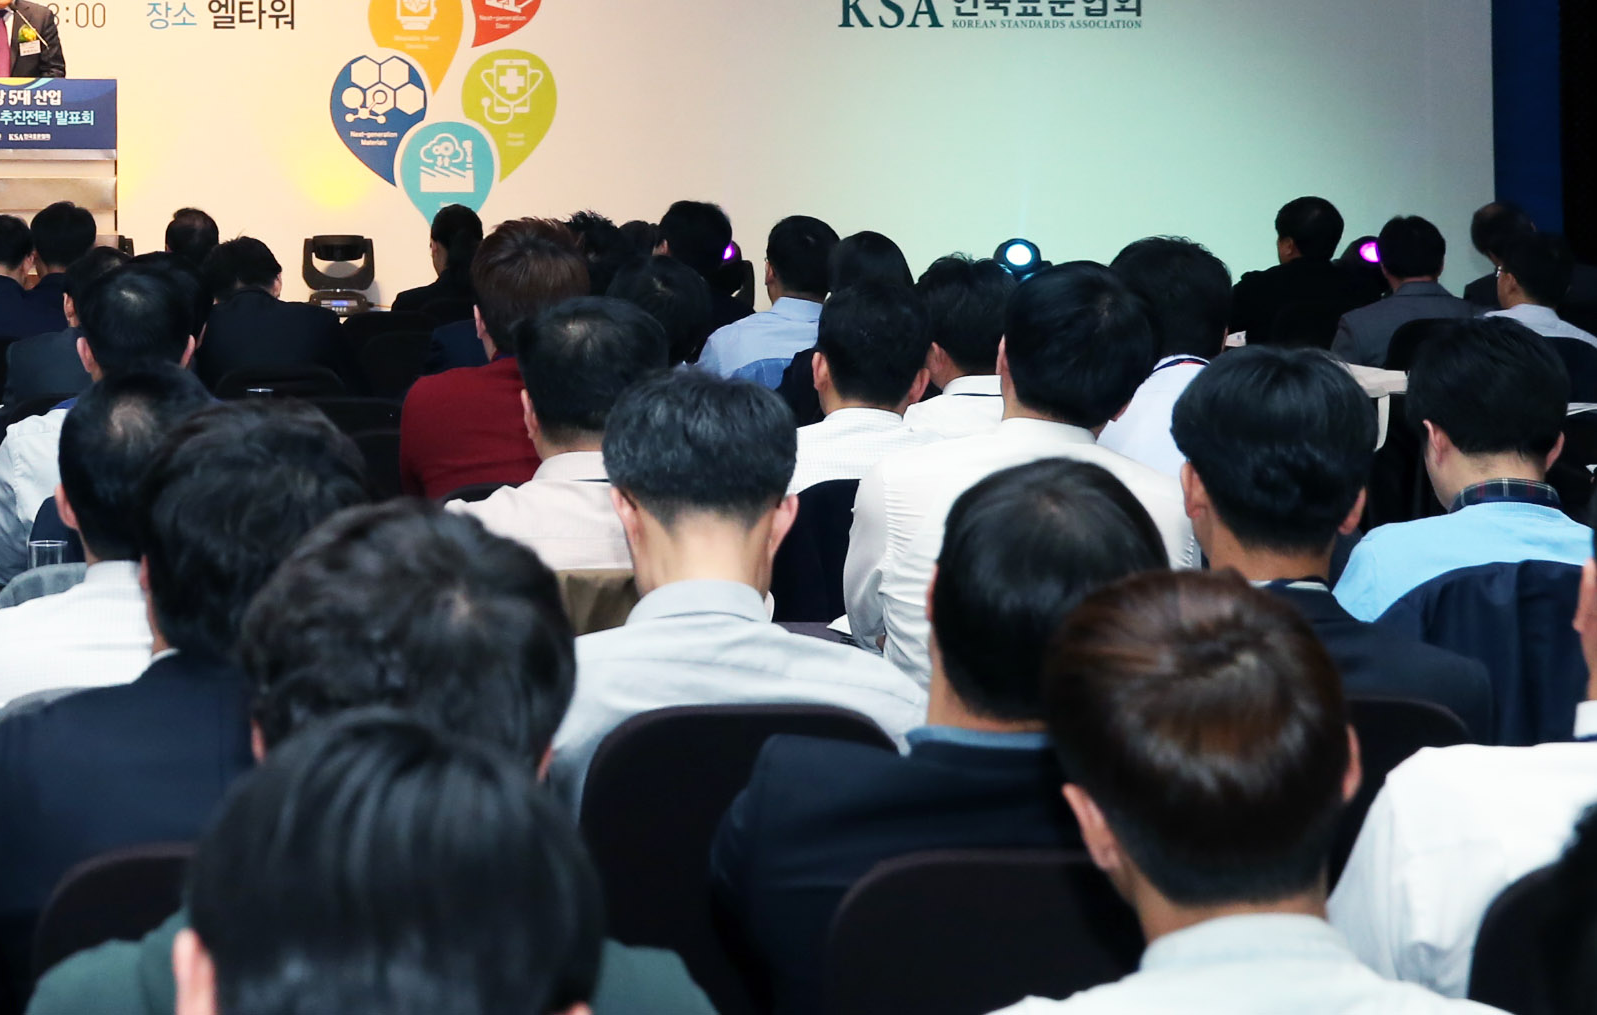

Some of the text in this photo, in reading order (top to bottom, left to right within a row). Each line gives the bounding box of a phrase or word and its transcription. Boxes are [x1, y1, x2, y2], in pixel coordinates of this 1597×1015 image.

[146, 1, 197, 29] 장소
[952, 19, 1142, 29] KOREAN STANDARDS ASSOCIATION
[8, 89, 31, 106] 5대
[34, 89, 62, 106] 산업
[0, 109, 52, 125] 추진전략
[55, 110, 94, 126] 발표회
[8, 133, 23, 141] KSA
